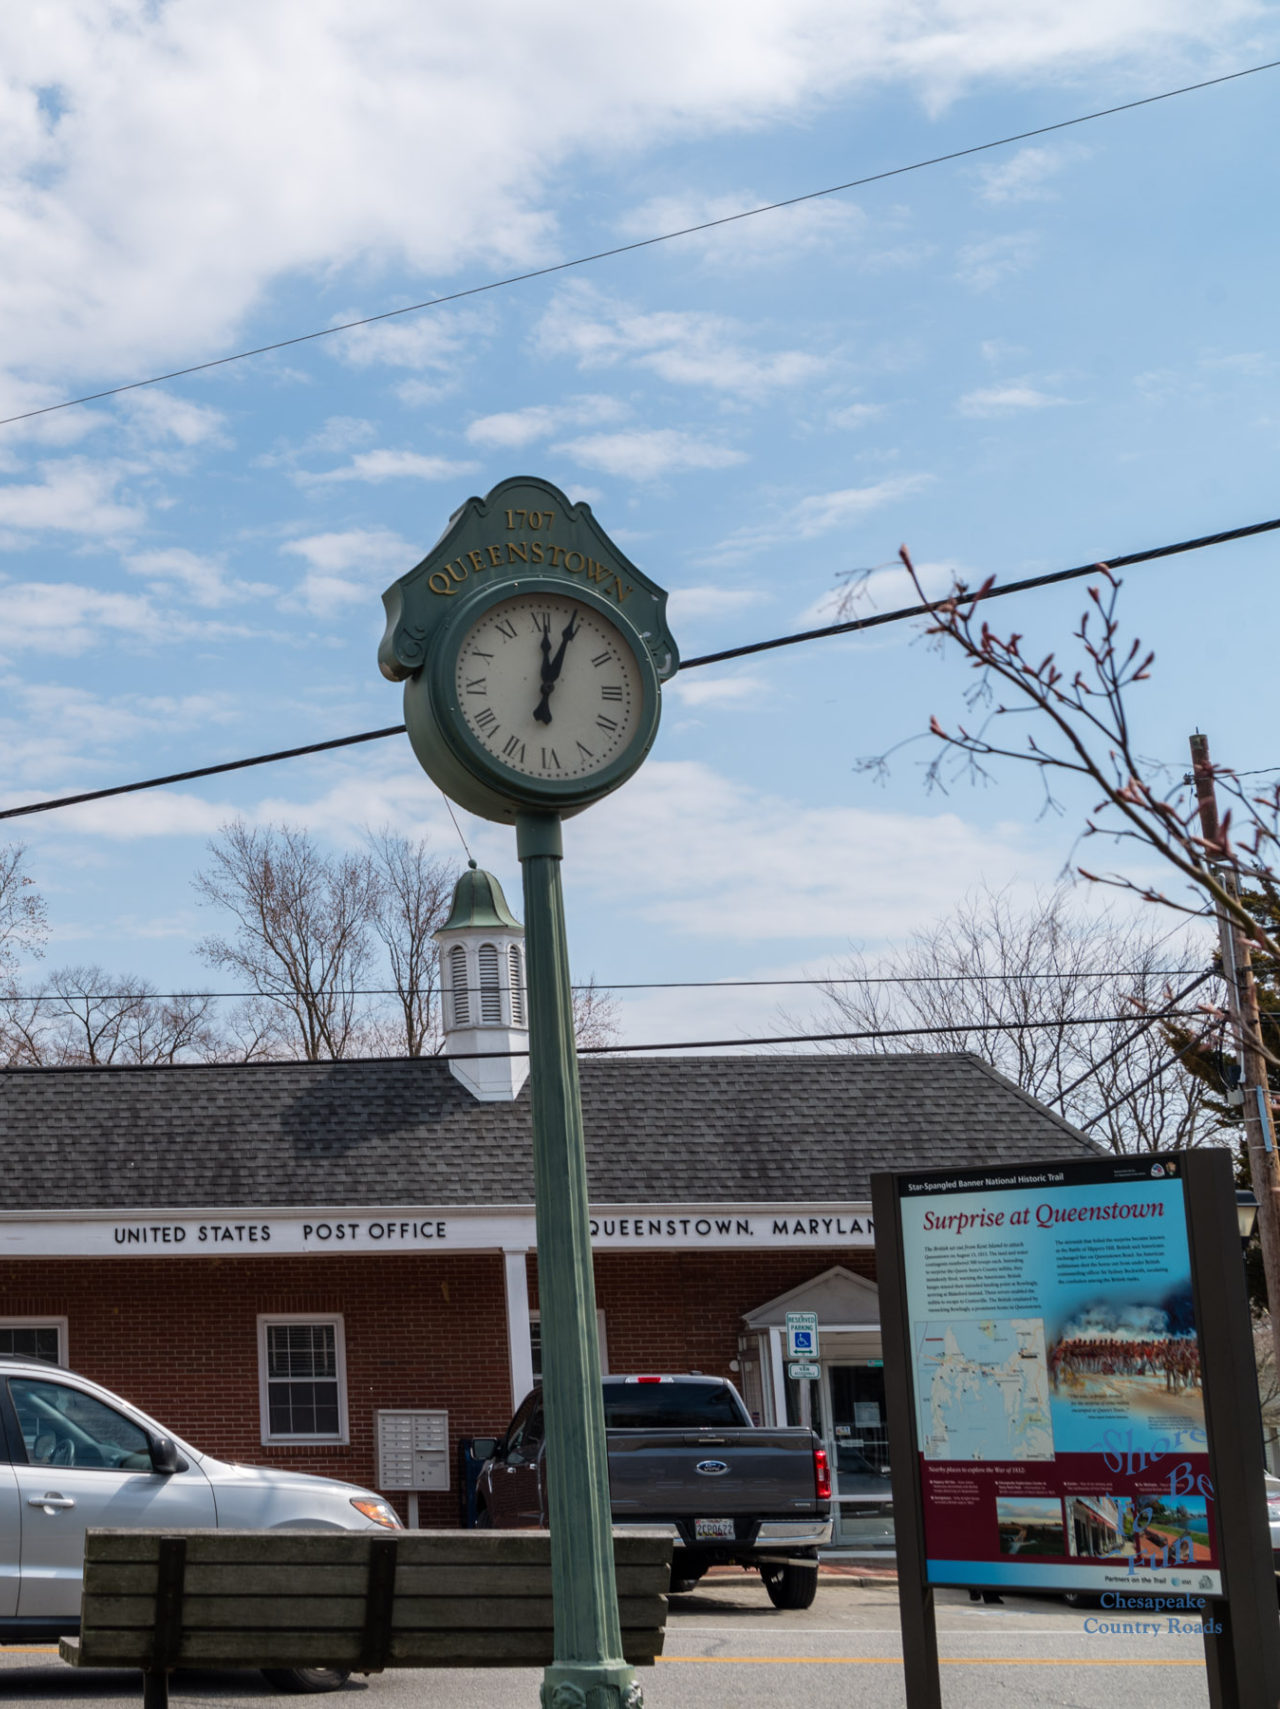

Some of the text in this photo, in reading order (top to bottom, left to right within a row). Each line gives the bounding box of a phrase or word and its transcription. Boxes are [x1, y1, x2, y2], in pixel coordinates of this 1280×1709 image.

[505, 508, 556, 531] 1707
[427, 541, 634, 604] QUEENSTOWN
[908, 1172, 1064, 1192] Star-Spangled Banner National Historic Trail
[773, 1218, 875, 1235] MARYLAN
[923, 1201, 1165, 1234] Surprise at Queenstown
[114, 1222, 447, 1243] UNITED STATES POST OFFICE
[1104, 1575, 1130, 1584] Partners
[1141, 1576, 1152, 1584] the
[1152, 1576, 1167, 1585] Trail
